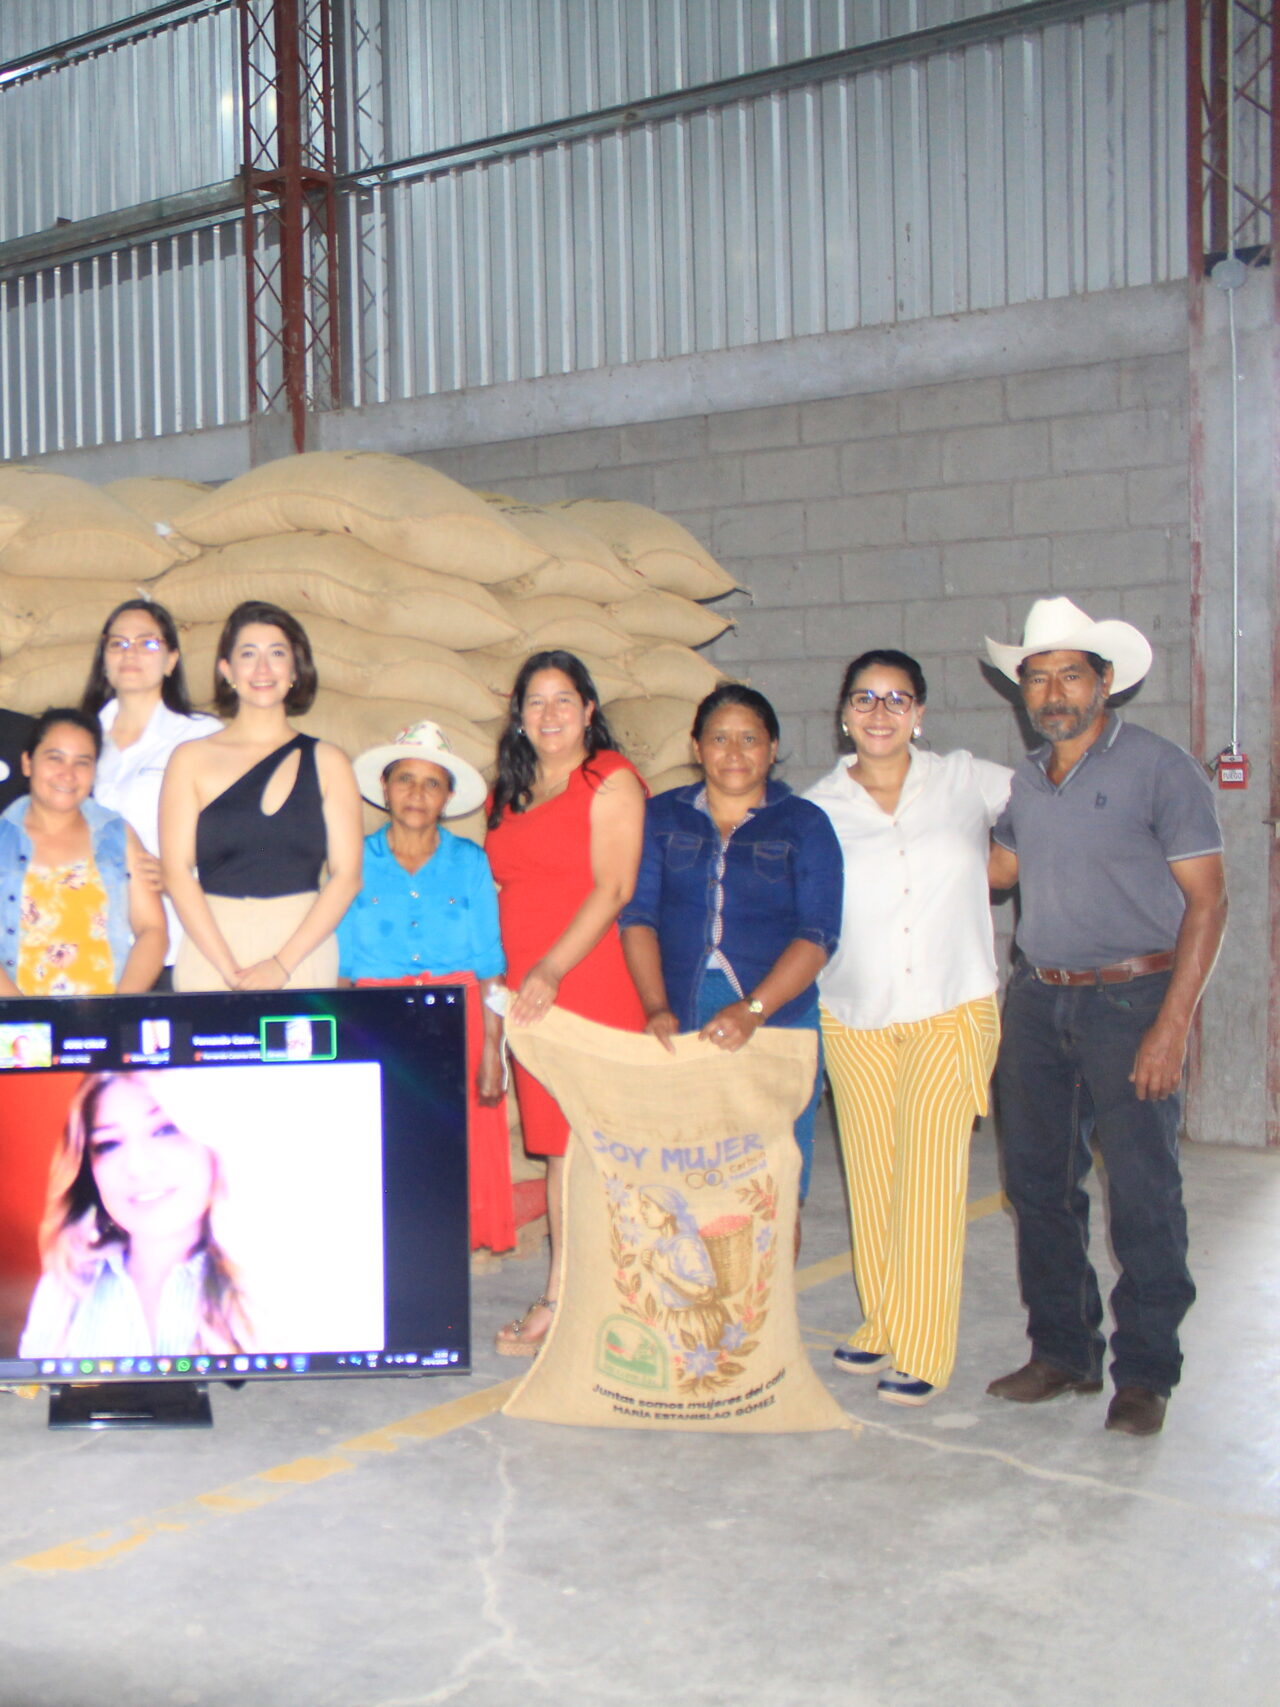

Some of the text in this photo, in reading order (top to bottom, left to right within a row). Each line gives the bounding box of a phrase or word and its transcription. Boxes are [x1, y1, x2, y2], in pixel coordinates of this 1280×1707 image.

[592, 1130, 765, 1173] SOY MUJER
[593, 1384, 635, 1405] Juntas
[638, 1399, 684, 1410] somos
[687, 1394, 742, 1411] mujeres
[745, 1383, 764, 1400] del
[613, 1395, 776, 1421] MARÍA ESTANISLAO GÓMEZ
